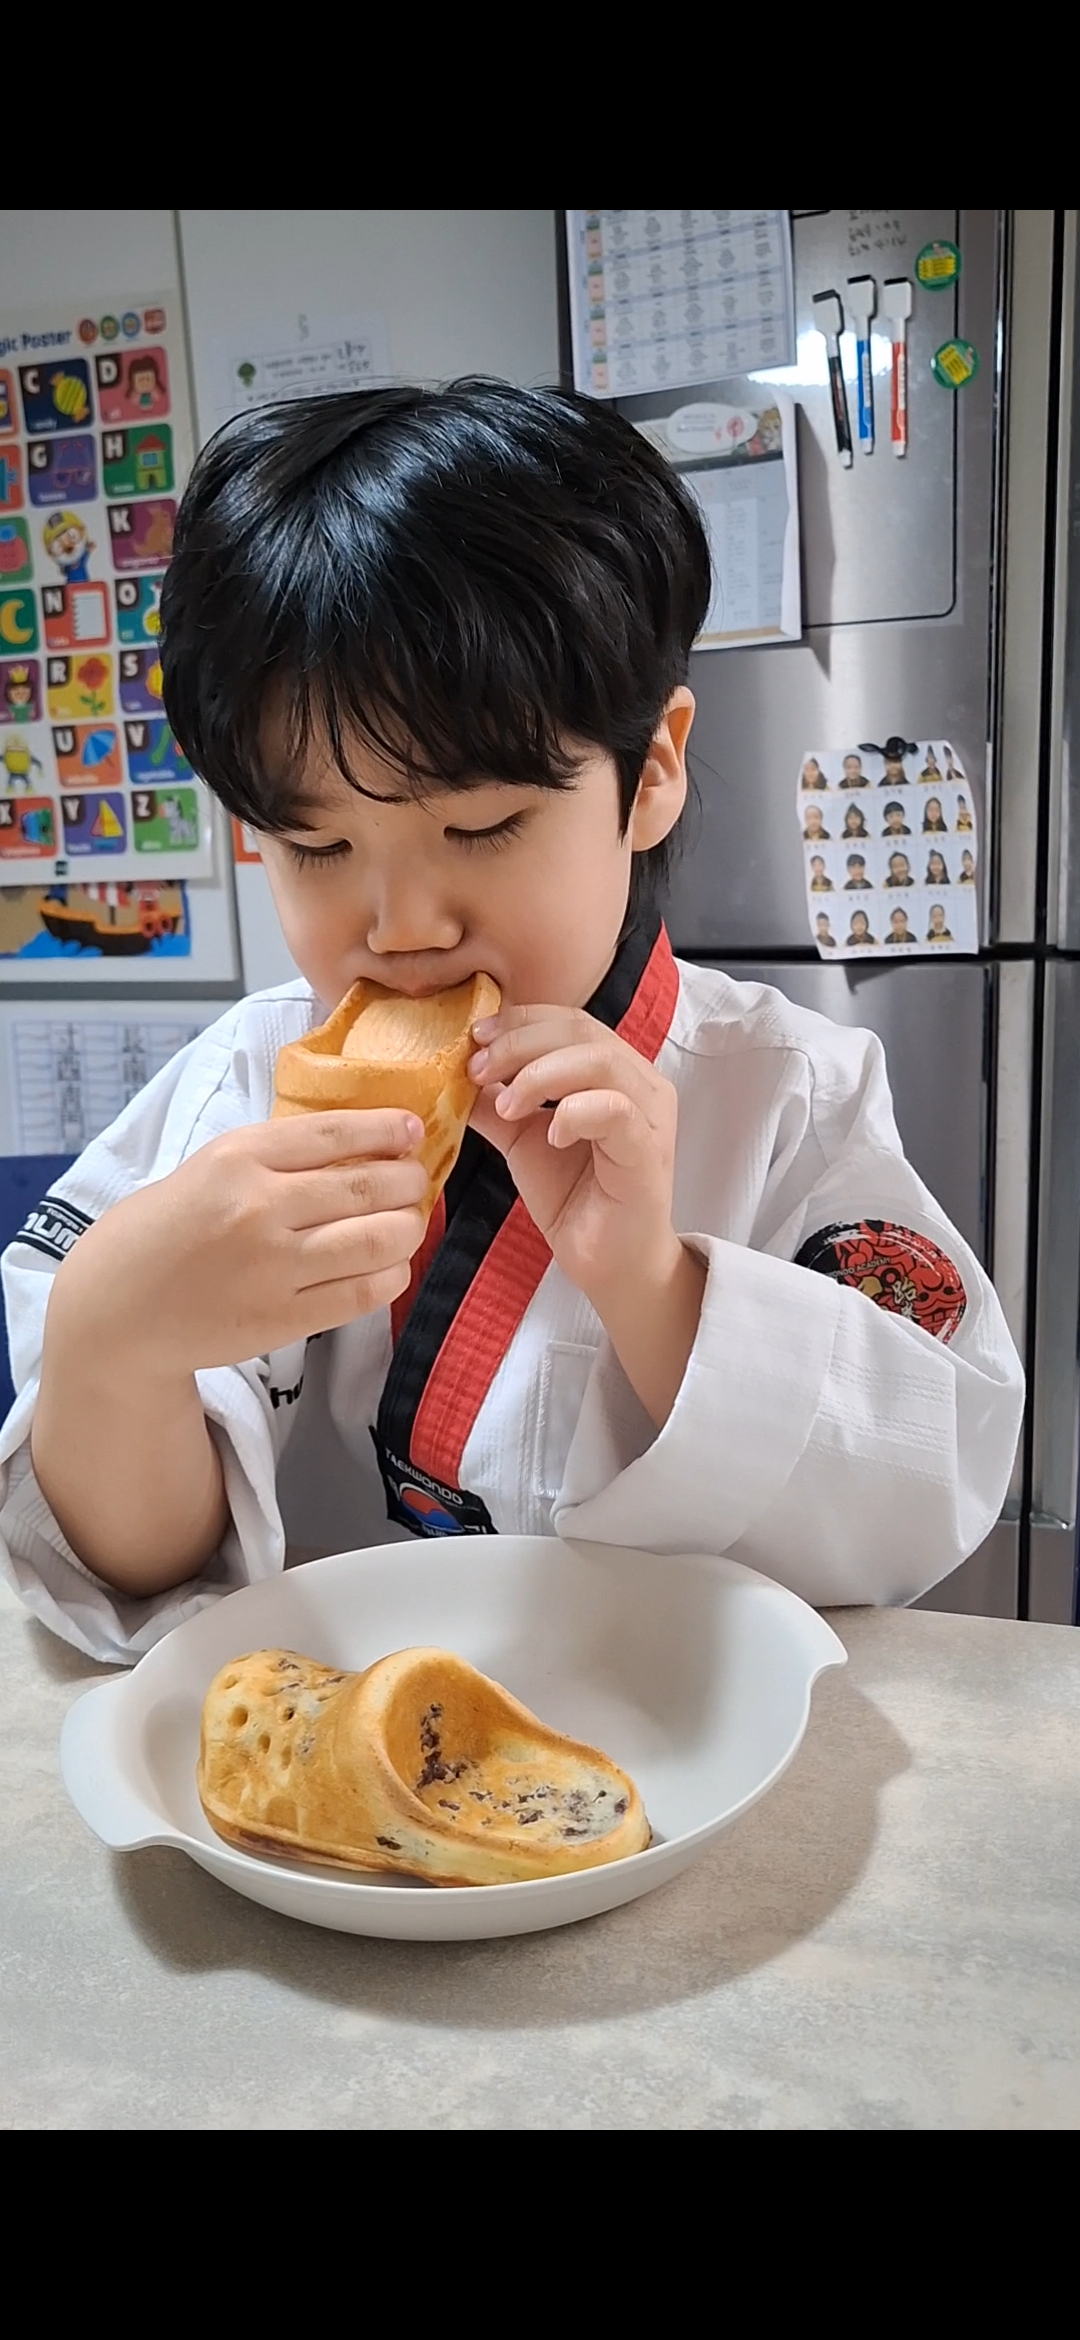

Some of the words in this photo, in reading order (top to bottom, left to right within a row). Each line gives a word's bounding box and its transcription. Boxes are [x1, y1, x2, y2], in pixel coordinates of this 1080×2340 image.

[21, 331, 72, 350] Poster
[25, 369, 40, 394] C
[99, 359, 118, 383] D
[31, 445, 47, 468] G
[105, 435, 124, 459] H
[112, 509, 131, 534] K
[45, 591, 63, 614] N
[118, 582, 137, 606] O
[50, 660, 67, 684] R
[123, 652, 139, 677] S
[55, 730, 74, 753] U
[128, 724, 147, 748] V
[64, 798, 81, 821] Y
[136, 793, 151, 818] Z
[855, 1257, 892, 1273] ACADEMY
[385, 1447, 464, 1505] TAEKWONDO
